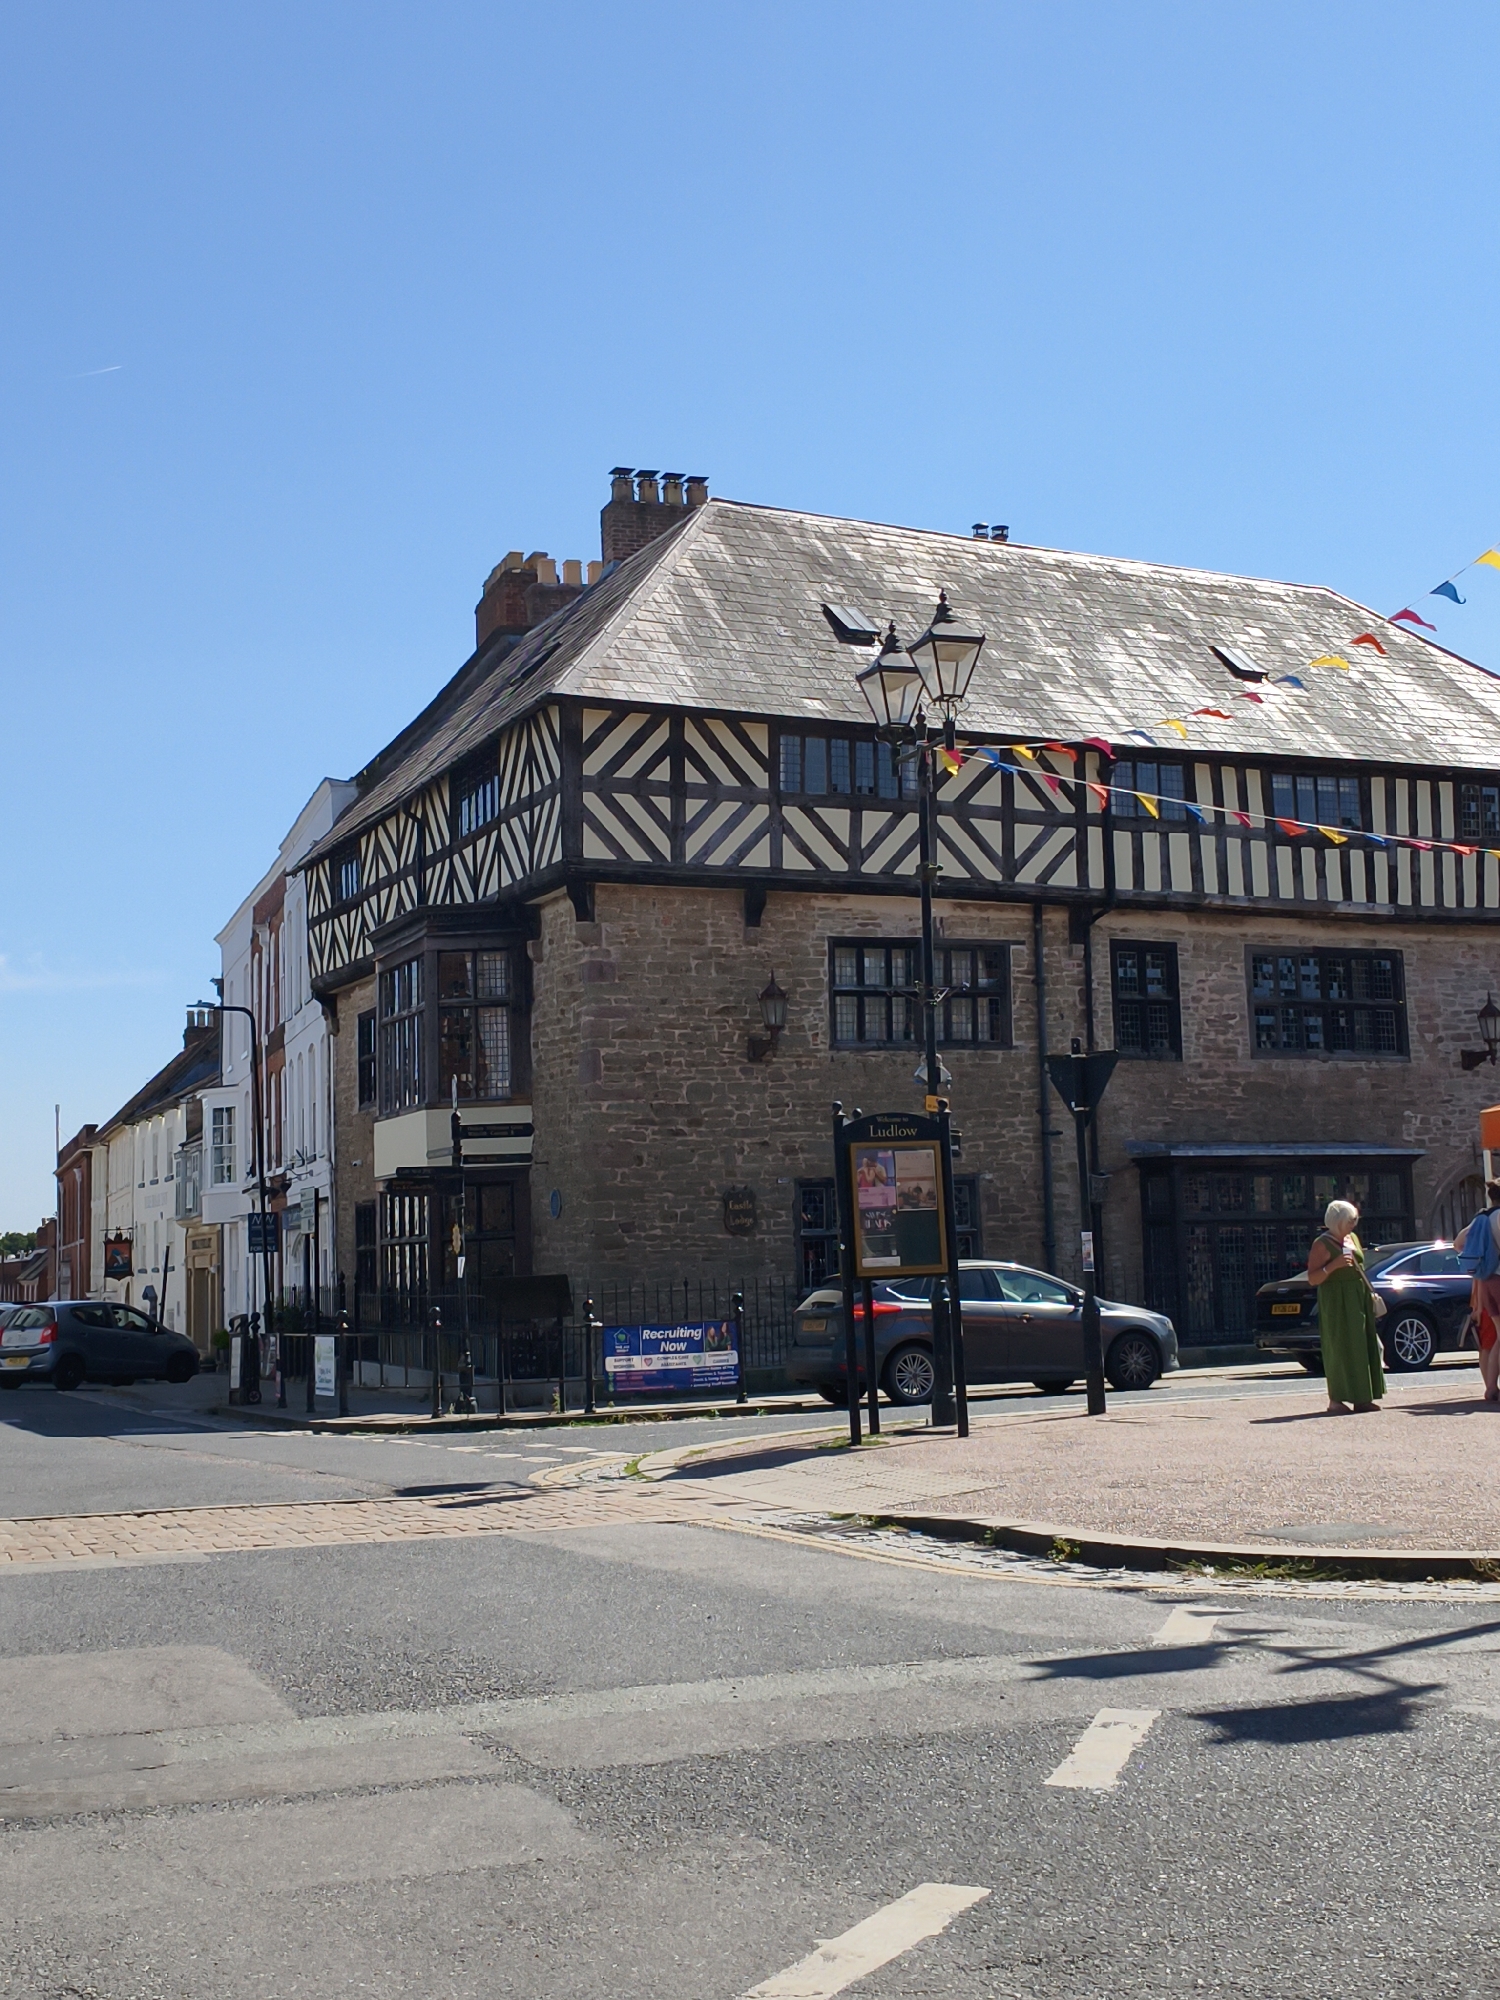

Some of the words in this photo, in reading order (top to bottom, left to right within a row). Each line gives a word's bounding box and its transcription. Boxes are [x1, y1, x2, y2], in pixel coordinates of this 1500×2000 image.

[869, 1124, 918, 1138] Ludlow
[728, 1200, 753, 1210] Castle
[729, 1214, 754, 1227] Lodge
[642, 1326, 702, 1341] Recruiting
[660, 1341, 687, 1353] Now
